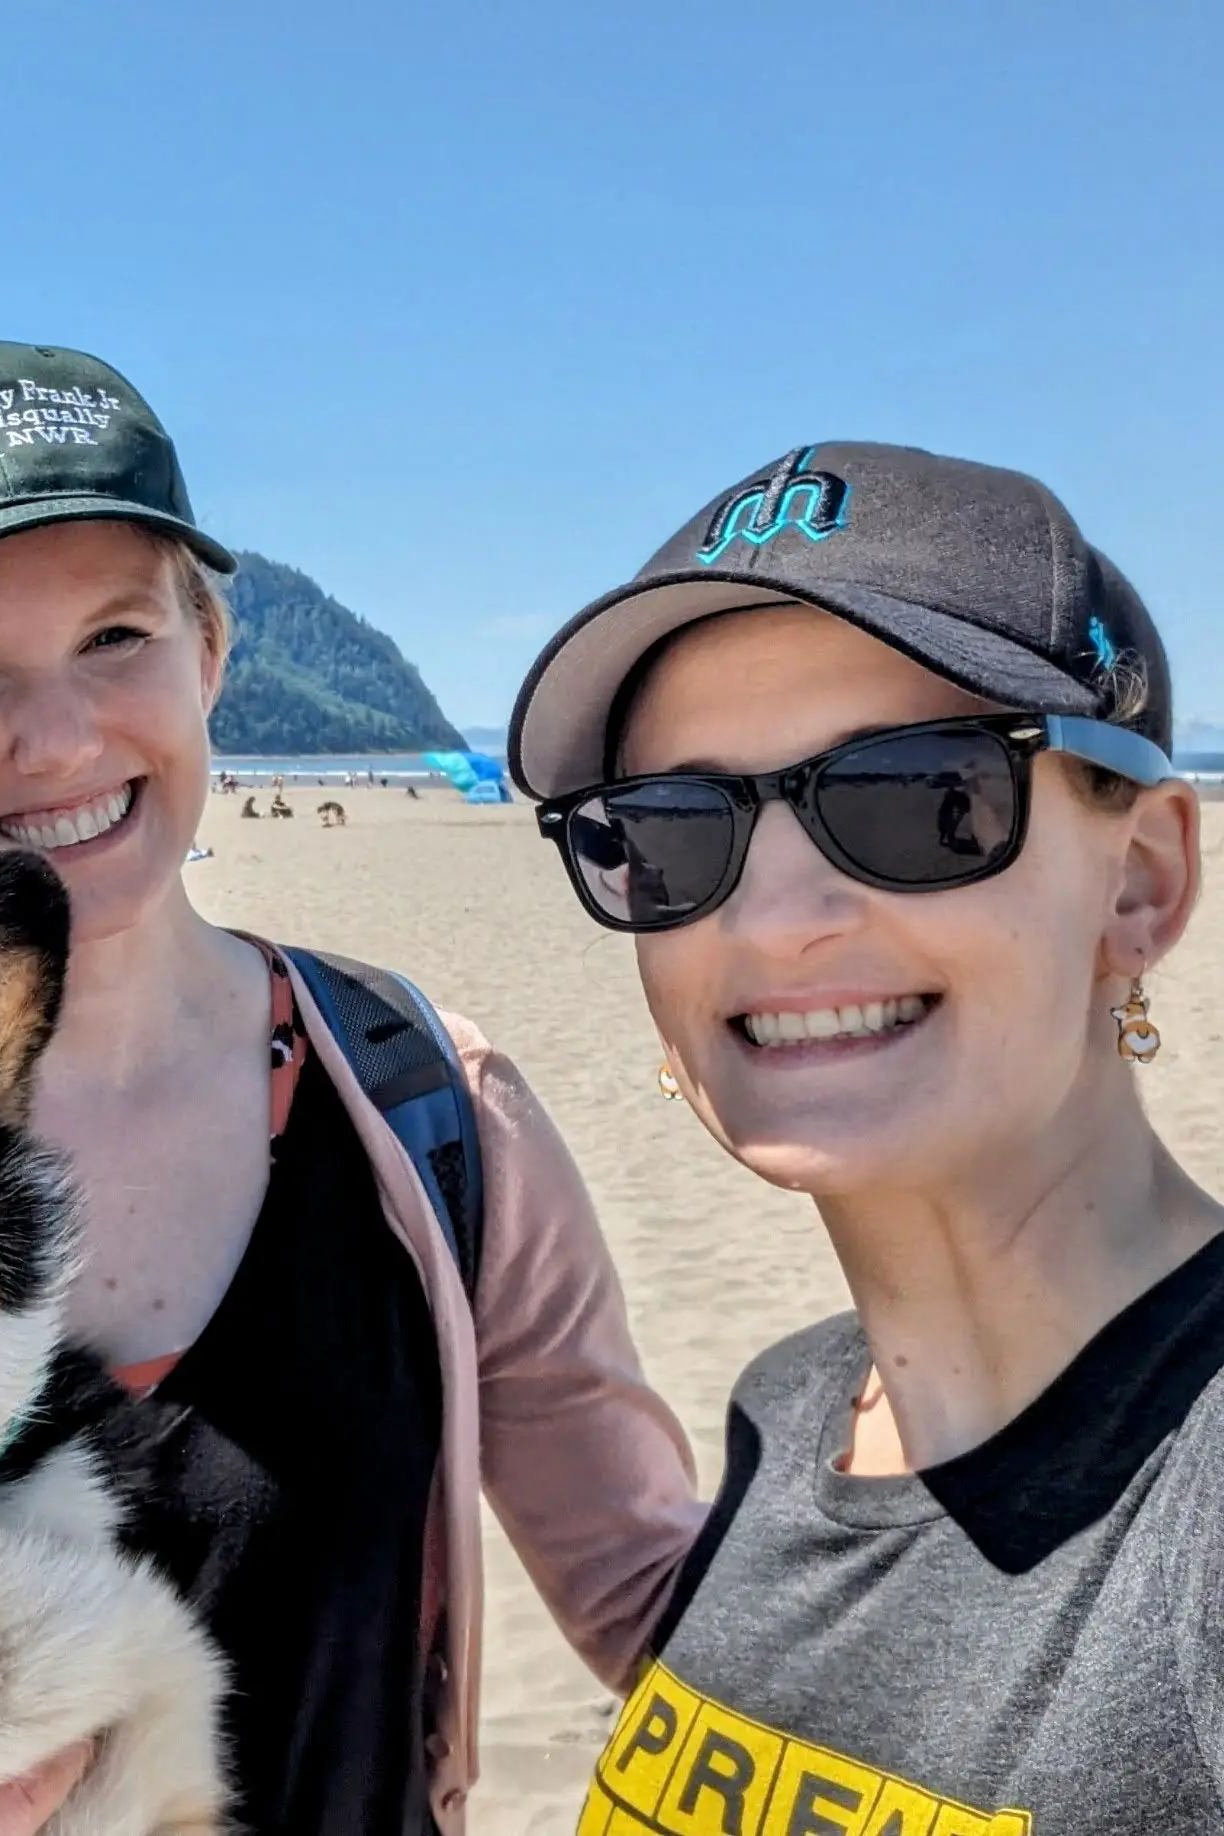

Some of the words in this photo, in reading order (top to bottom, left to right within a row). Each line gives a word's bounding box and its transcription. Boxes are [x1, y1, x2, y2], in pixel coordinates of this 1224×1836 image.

[18, 379, 97, 408] Frank
[97, 388, 121, 410] Jr
[6, 426, 99, 447] NWR
